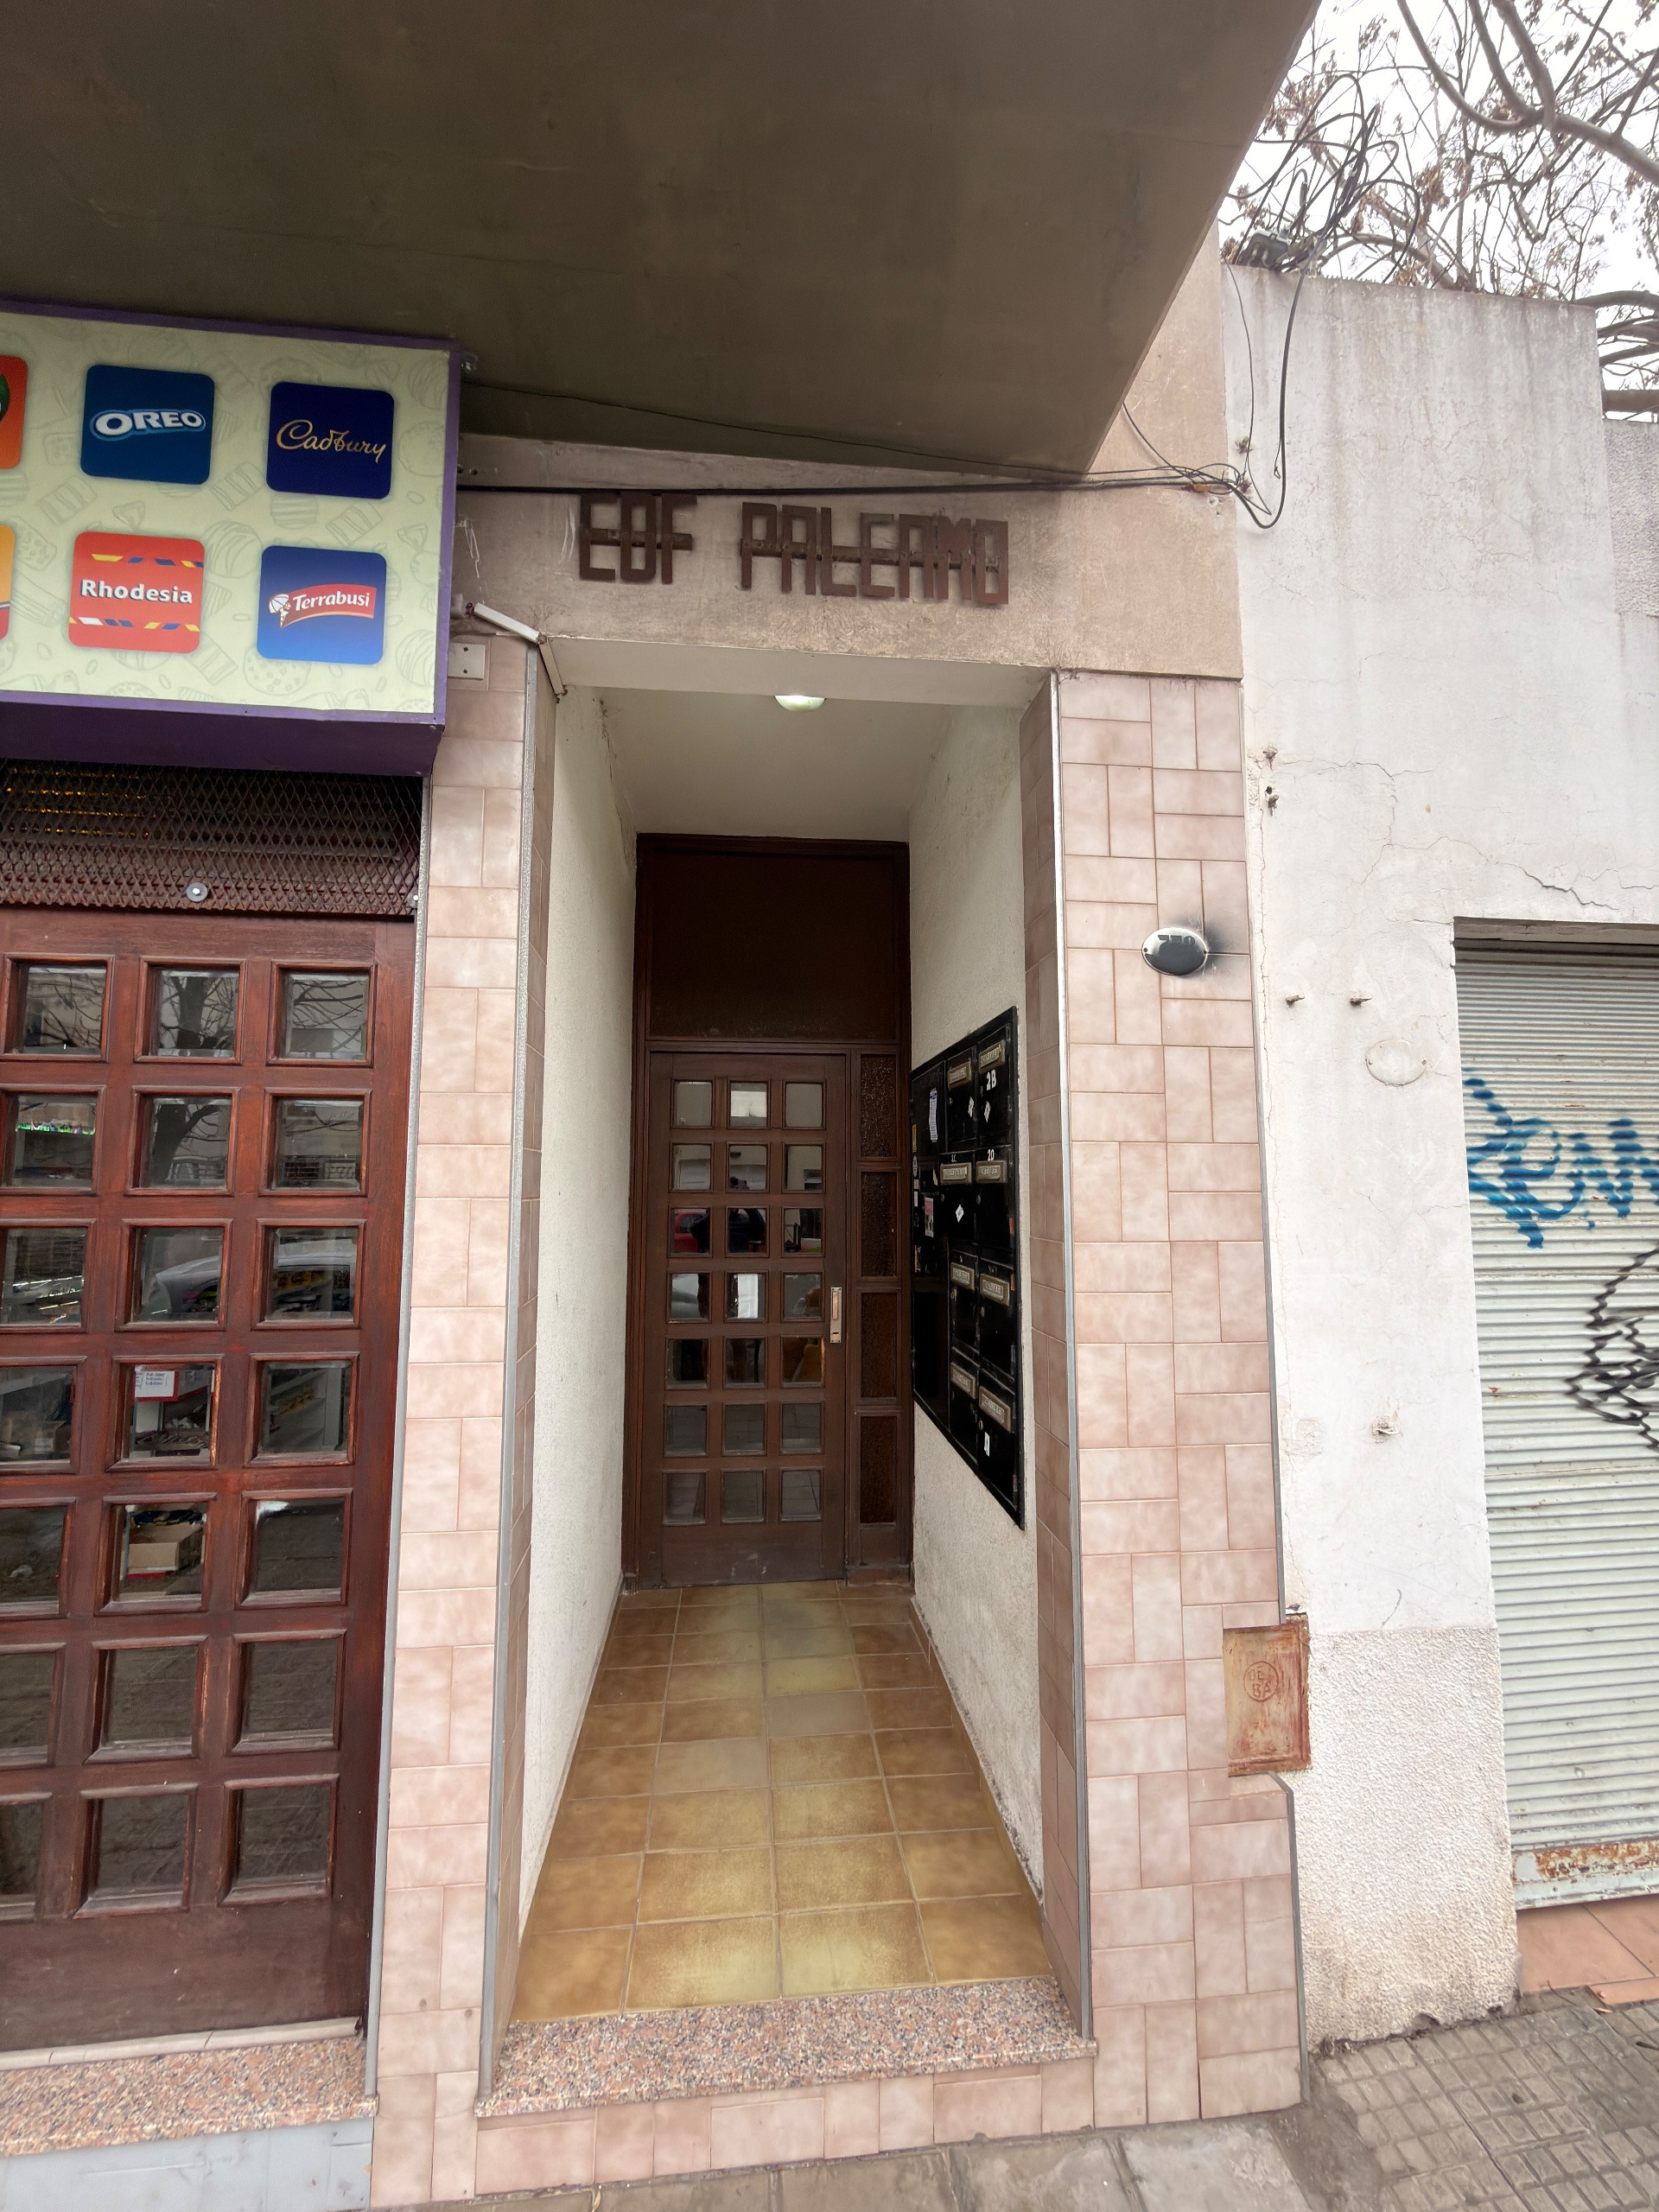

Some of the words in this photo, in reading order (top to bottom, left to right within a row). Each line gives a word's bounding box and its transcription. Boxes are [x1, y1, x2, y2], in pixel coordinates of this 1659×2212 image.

[94, 410, 204, 436] OREO
[276, 419, 386, 463] Cadbury
[741, 501, 1009, 605] PALERMO
[79, 579, 194, 605] Rhodesia
[292, 591, 371, 612] Terrabusi
